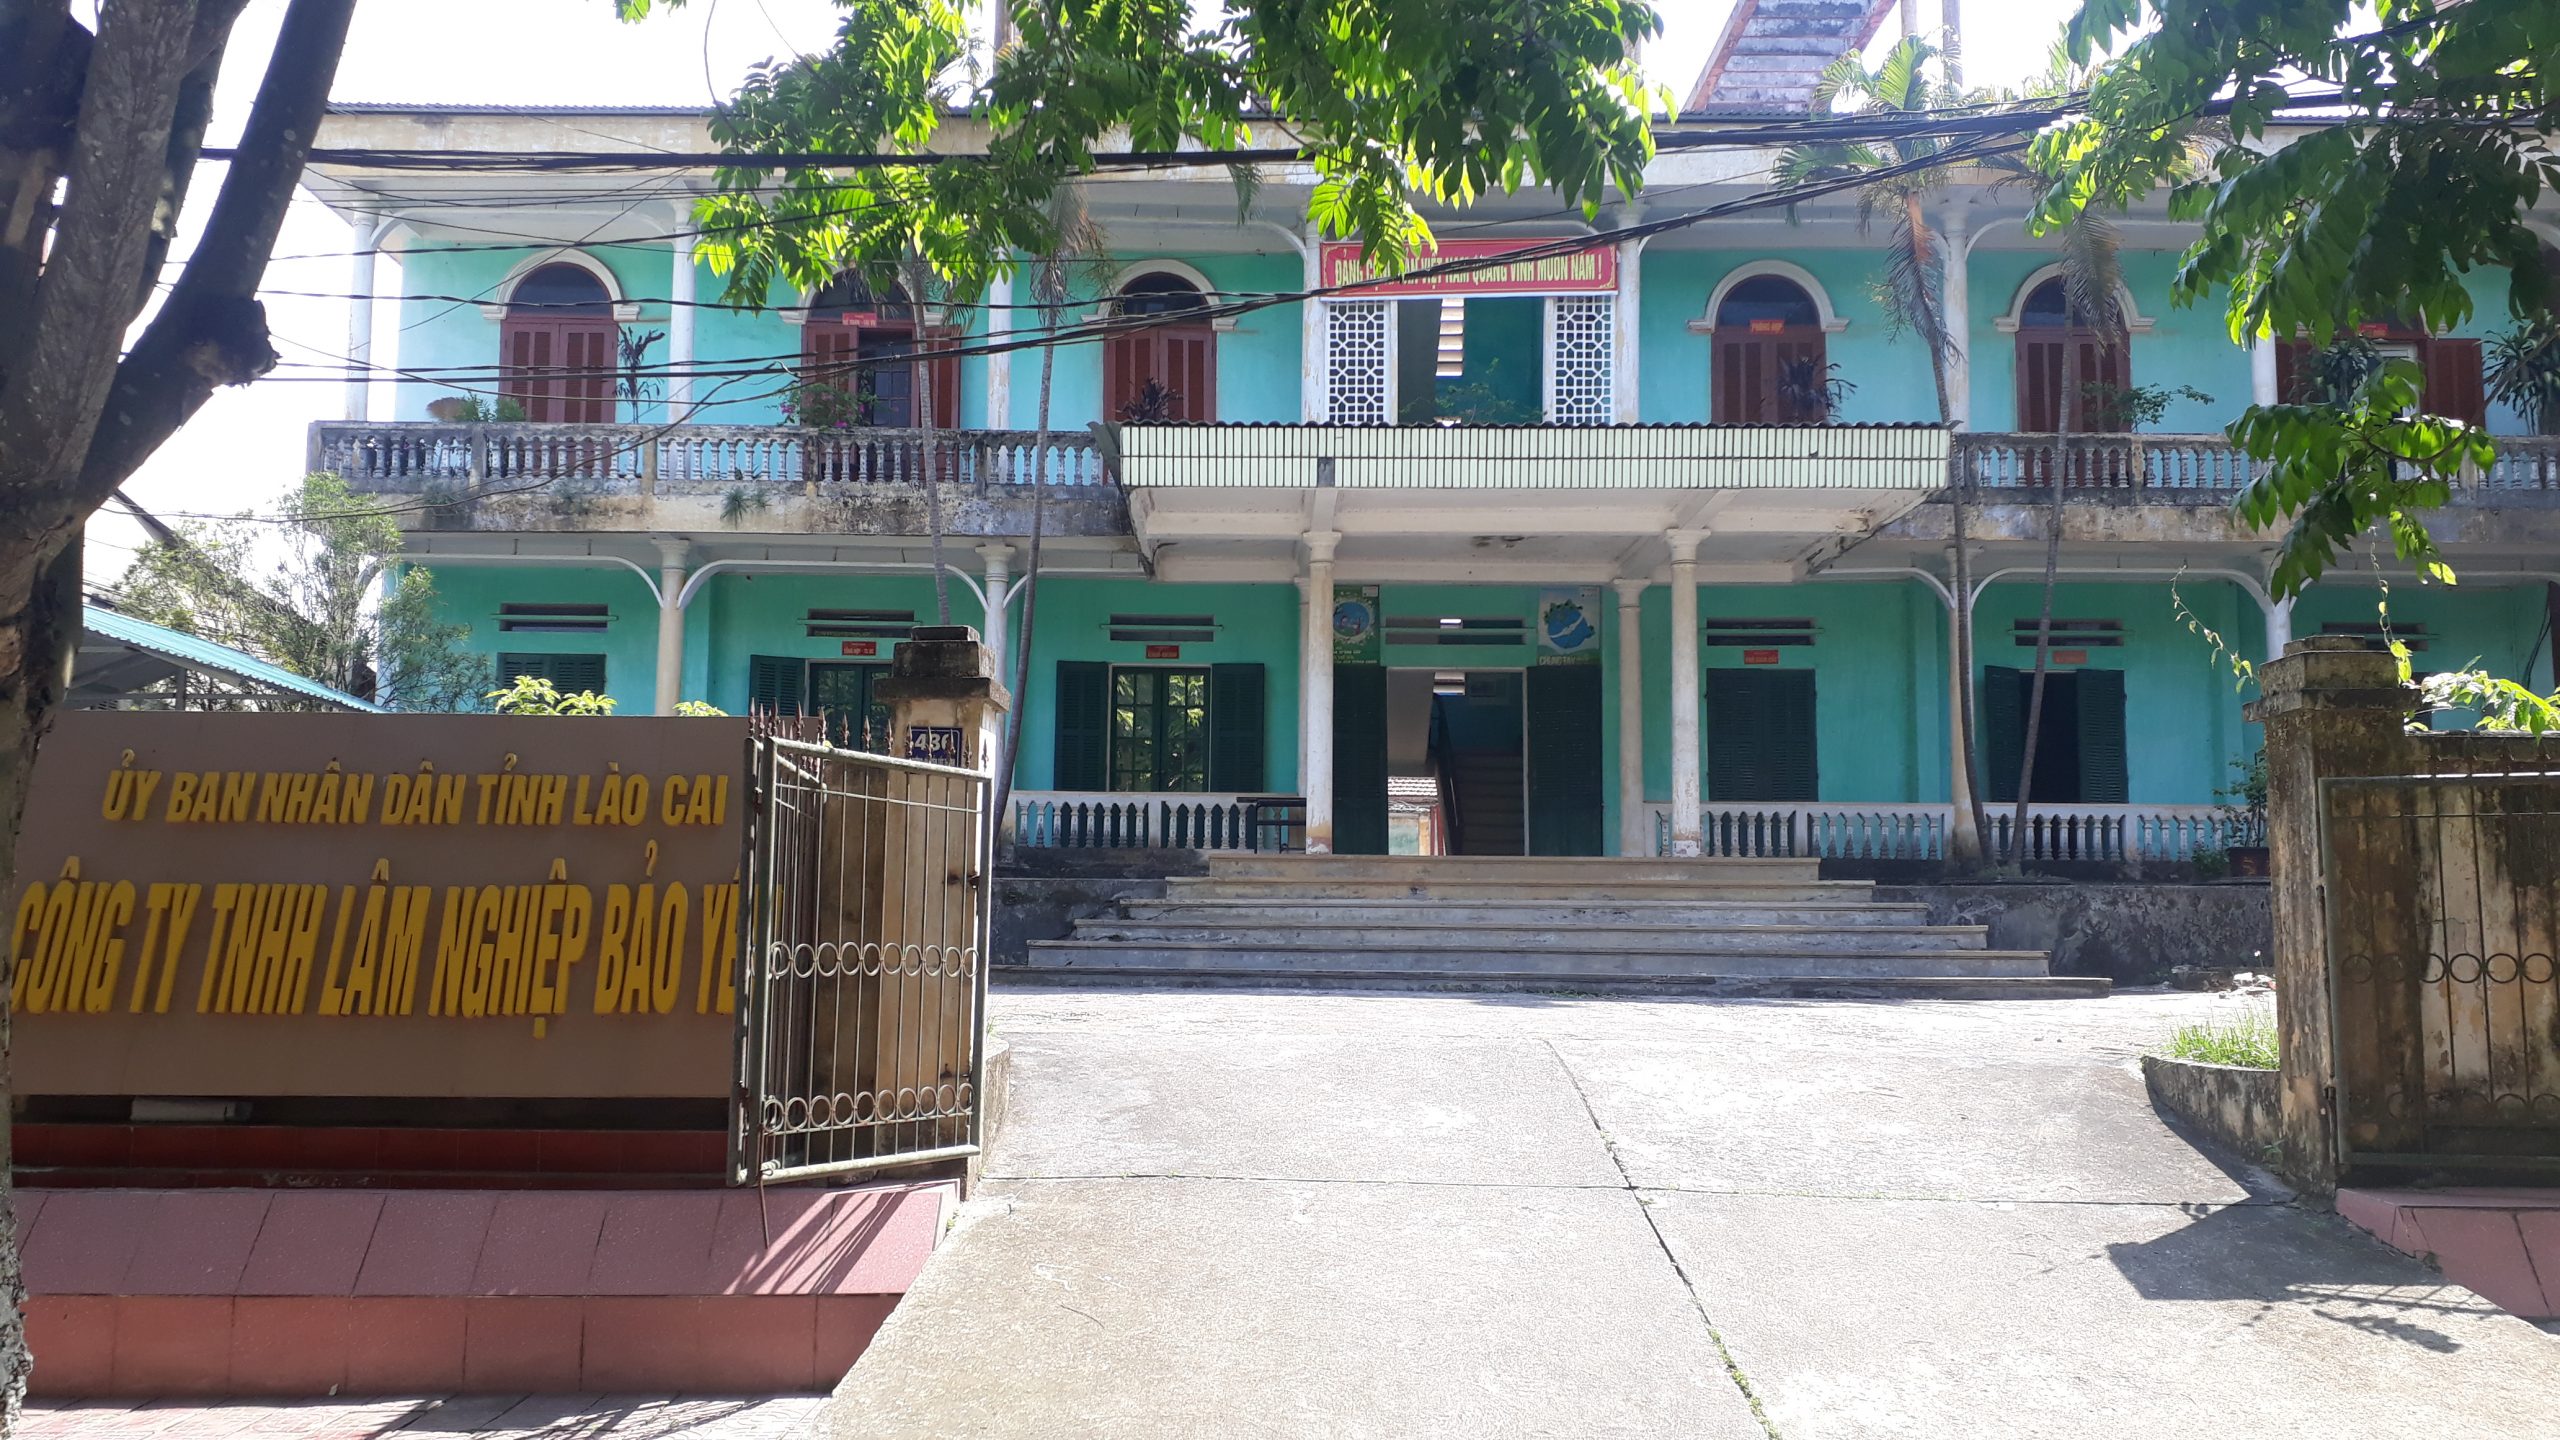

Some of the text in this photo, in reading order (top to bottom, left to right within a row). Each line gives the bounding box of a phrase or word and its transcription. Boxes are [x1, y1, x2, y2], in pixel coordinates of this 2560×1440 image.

[1510, 257, 1534, 283] VINH
[102, 748, 731, 829] ỦY BAN NHÂN DÂN TỈNH LÀO CAI
[9, 855, 137, 1016] CÔNG
[127, 882, 203, 1017] TY
[195, 883, 329, 1018] TNHH
[316, 858, 433, 1018] LÂM
[427, 858, 594, 1041] NGHIỆP
[592, 839, 690, 1018] BẢO
